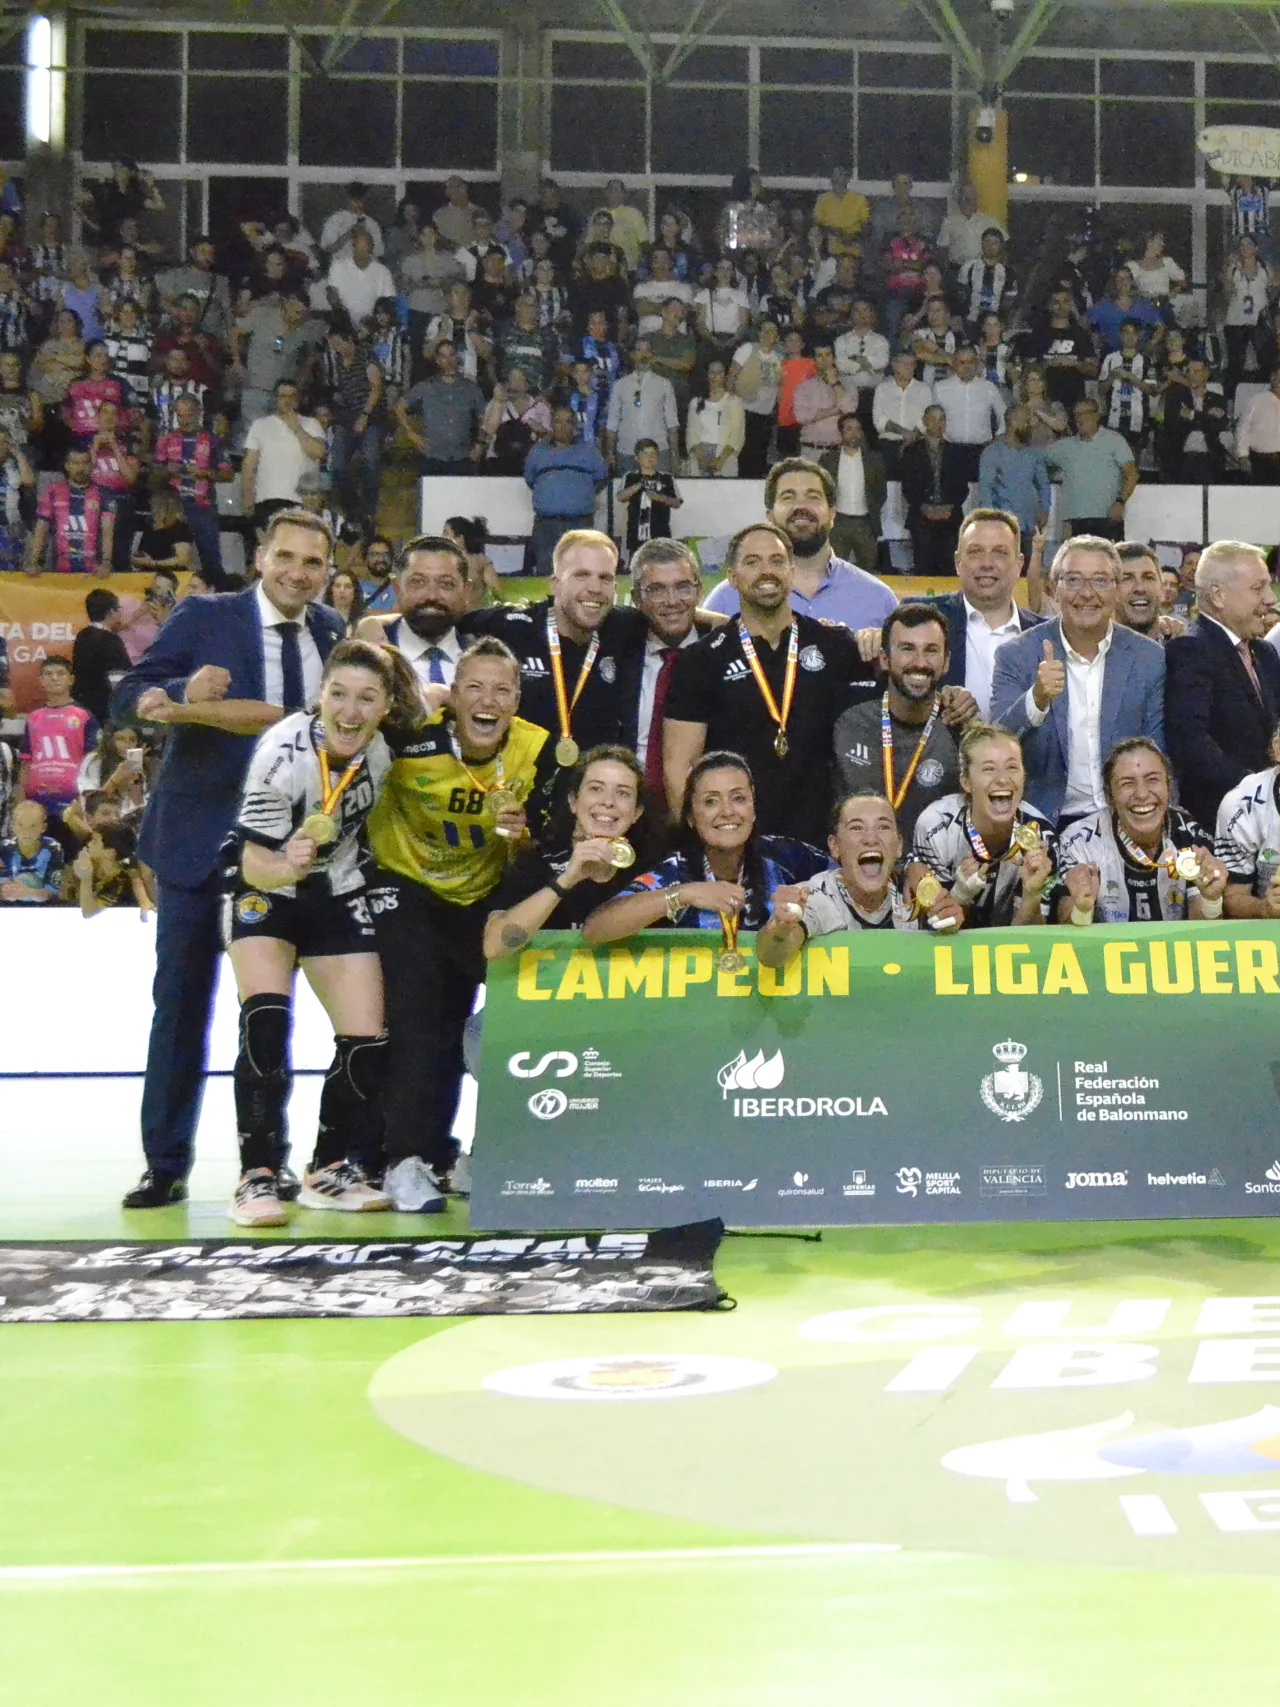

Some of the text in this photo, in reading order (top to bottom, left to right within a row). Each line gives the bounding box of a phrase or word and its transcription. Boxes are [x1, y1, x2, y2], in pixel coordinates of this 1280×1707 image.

[448, 787, 487, 815] 68
[934, 941, 1090, 996] LIGA
[1074, 1060, 1108, 1073] Real
[1075, 1075, 1160, 1090] Federación
[1076, 1091, 1146, 1107] Española
[734, 1097, 889, 1117] IBERDROLA
[1076, 1108, 1189, 1122] de Balonmano
[575, 1178, 619, 1188] molten
[925, 1172, 961, 1180] MELILLA
[925, 1179, 954, 1187] SPORT
[1147, 1172, 1207, 1186] helvetia
[704, 1179, 743, 1188] IBERIA
[925, 1186, 962, 1195] CAPITAL
